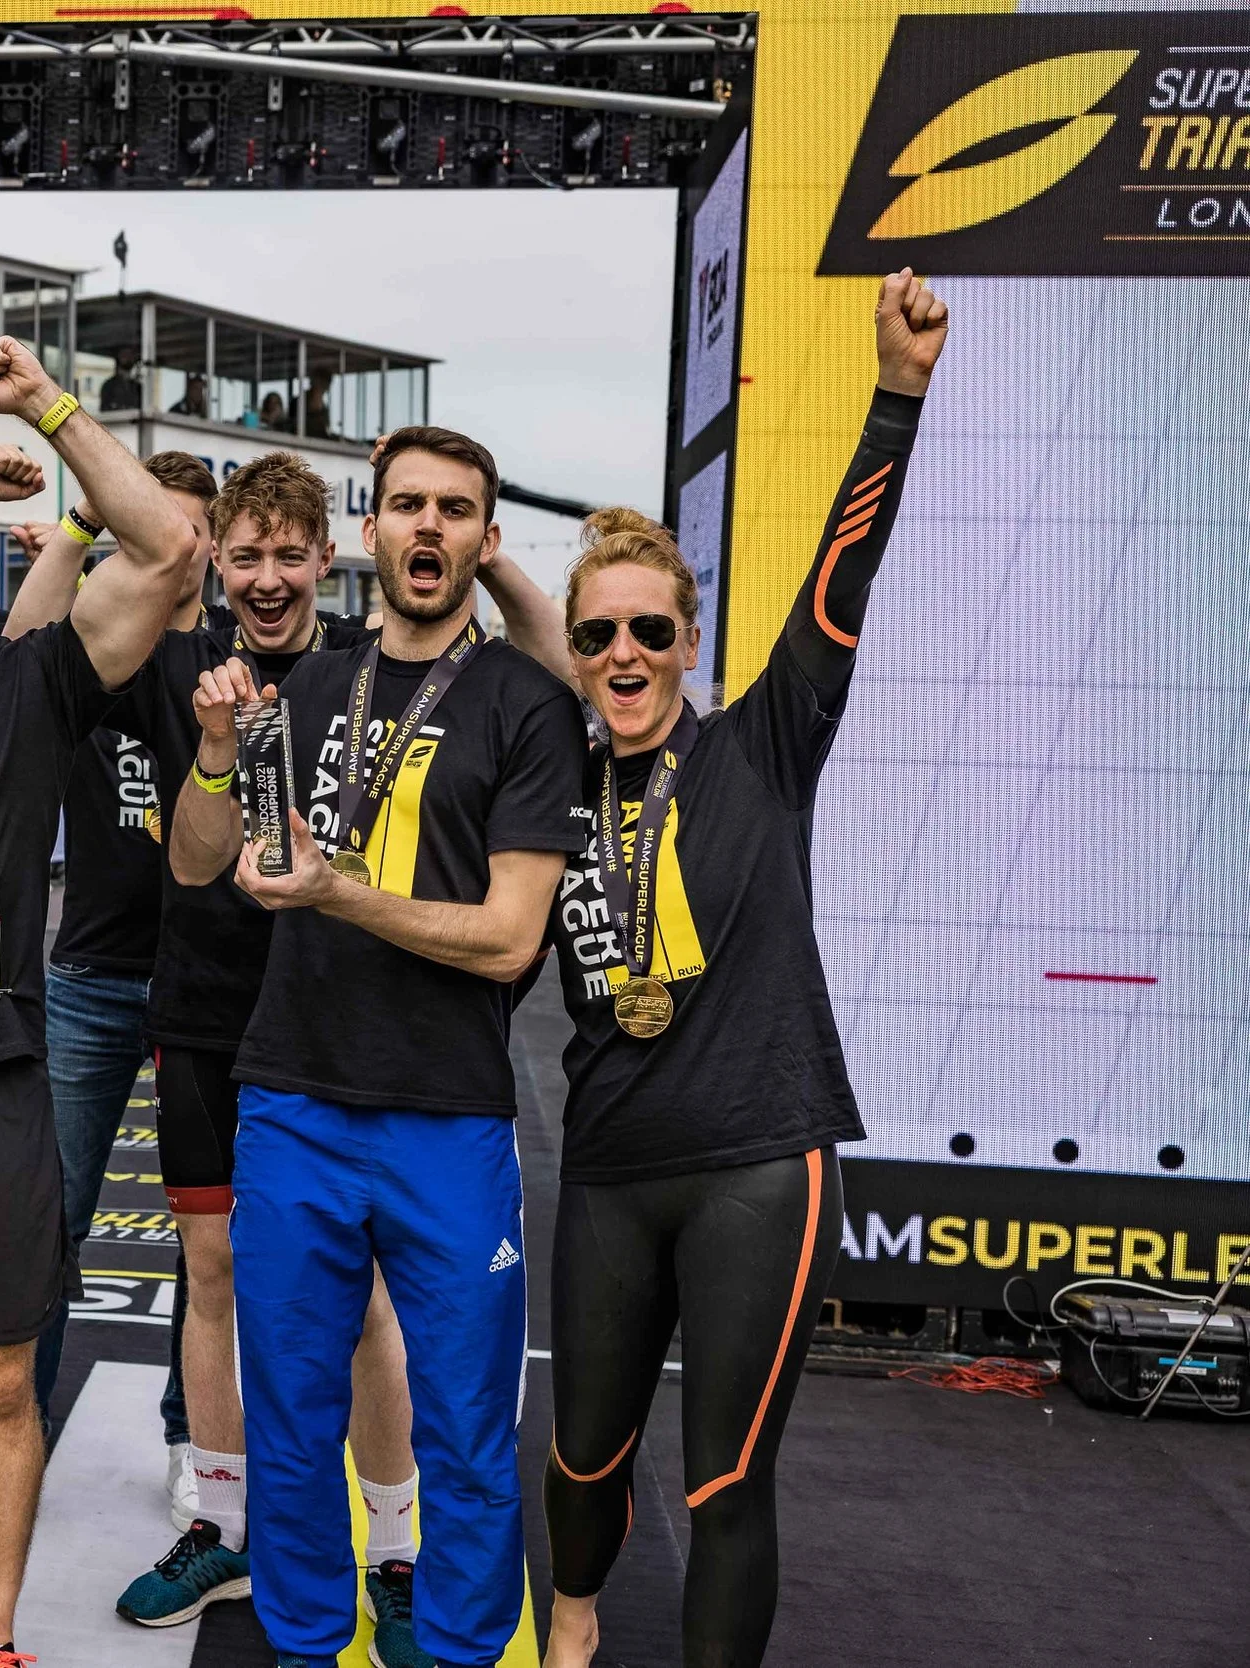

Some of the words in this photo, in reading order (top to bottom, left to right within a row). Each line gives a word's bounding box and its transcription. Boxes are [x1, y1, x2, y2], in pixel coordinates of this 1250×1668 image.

[347, 666, 370, 784] #IAMSUPERLEAGUE
[369, 684, 437, 799] #IAMSUPERLEAGUE
[256, 762, 268, 790] 2021
[267, 766, 282, 845] CHAMPIONS
[634, 827, 656, 964] #IAMSUPERLEAGUE
[677, 963, 703, 978] RUN
[489, 1252, 520, 1273] adidas
